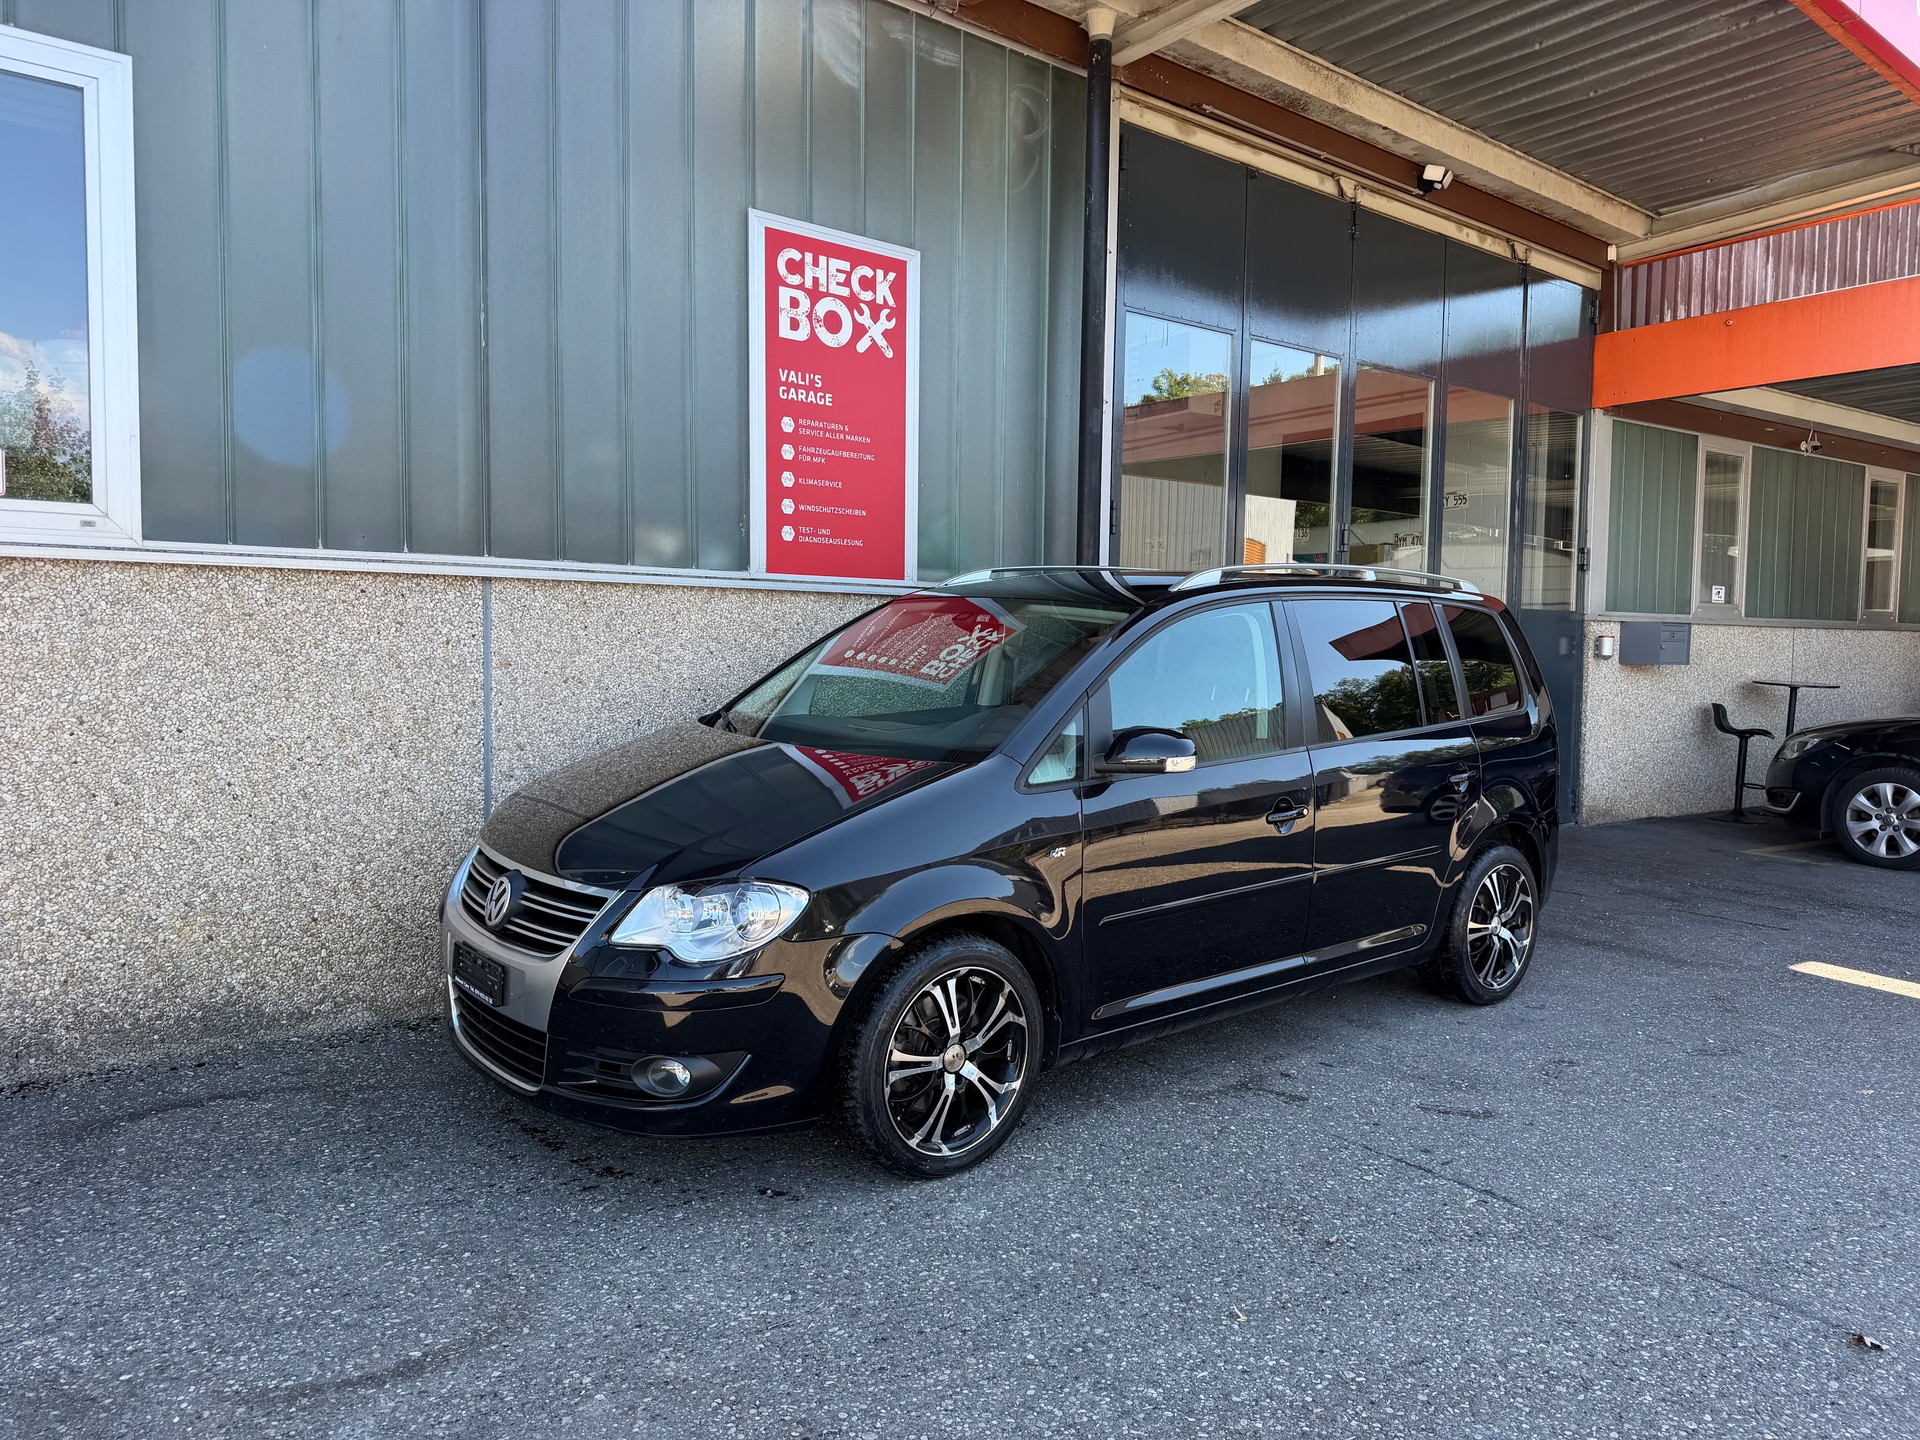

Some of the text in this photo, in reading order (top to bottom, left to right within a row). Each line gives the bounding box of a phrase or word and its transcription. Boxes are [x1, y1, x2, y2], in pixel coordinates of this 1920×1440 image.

[777, 248, 897, 307] CHECK
[779, 286, 896, 359] BOX
[779, 386, 833, 406] GARAGE
[798, 419, 844, 431] REPARATUREN
[798, 428, 871, 443] SERVICE ALLER MARKEN
[798, 446, 875, 461] FAHRZEUGAUFBEREITUNG
[798, 454, 812, 462] FÜR
[798, 478, 843, 488] KLIMASERVICE
[1453, 494, 1468, 506] 555
[798, 504, 867, 516] WINDSCHUTZSCHEIBEN
[798, 526, 816, 534] TEST-
[798, 535, 864, 547] DIAGNOSEAUSLESUNG
